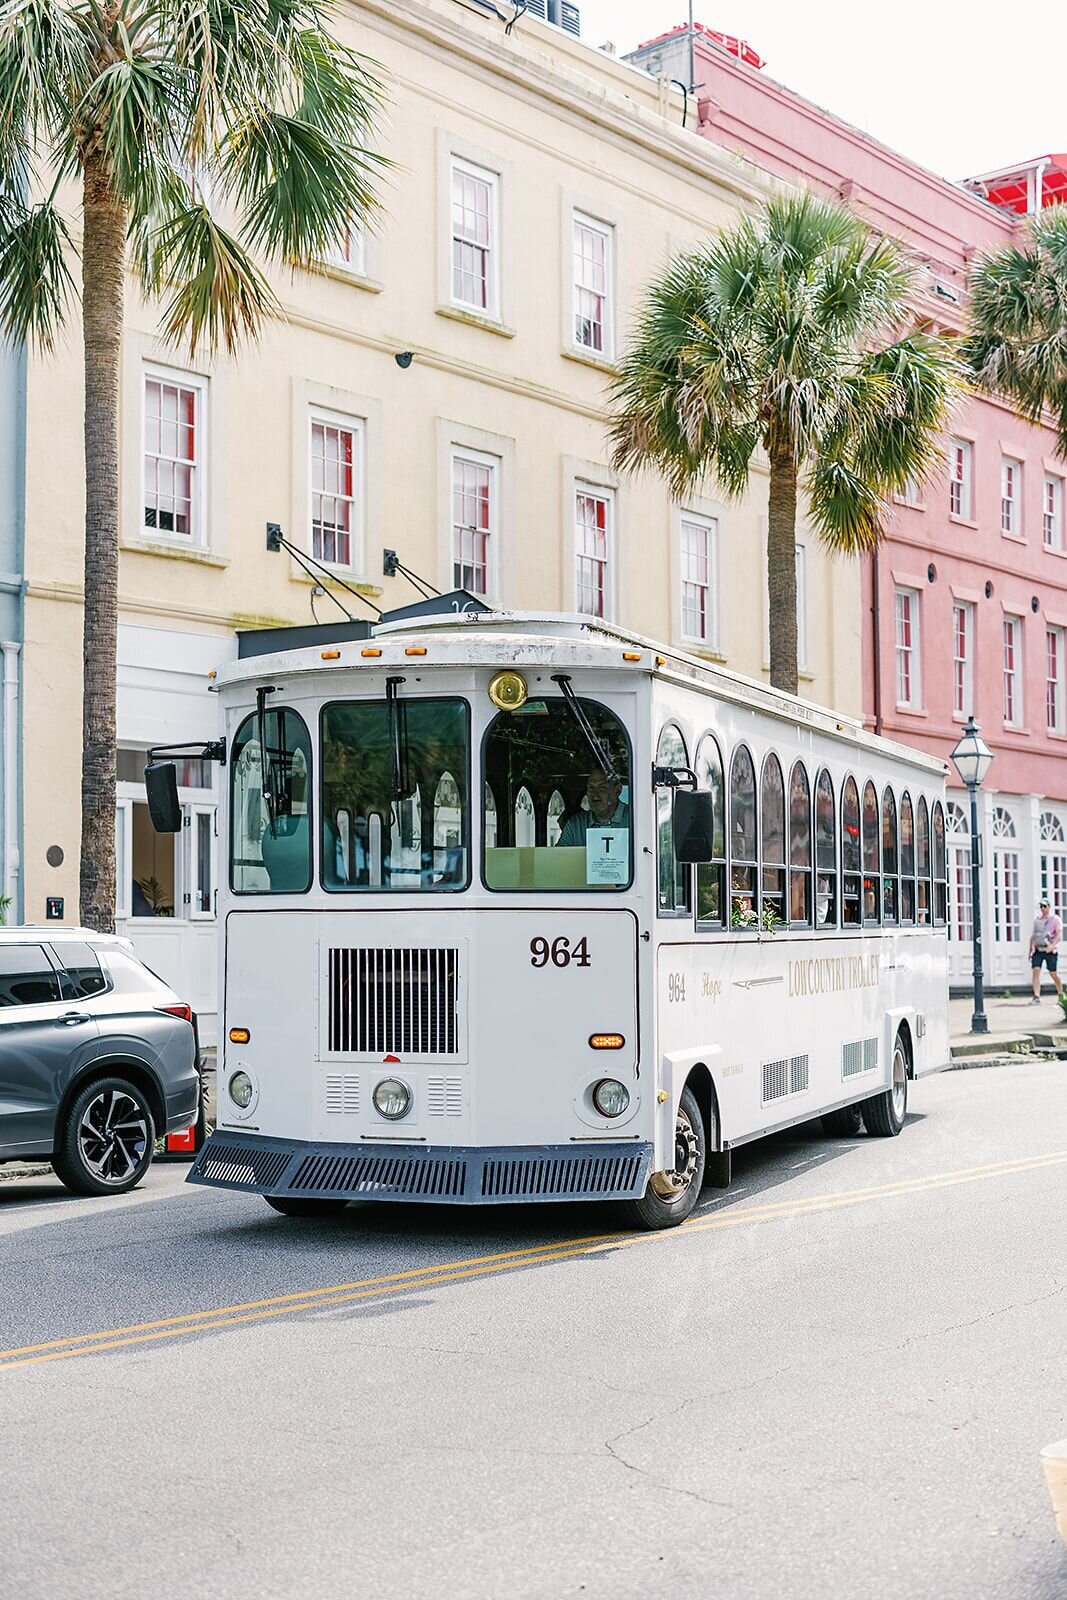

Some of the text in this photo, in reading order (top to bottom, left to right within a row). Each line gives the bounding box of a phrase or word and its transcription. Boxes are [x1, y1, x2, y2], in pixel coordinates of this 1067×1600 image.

[601, 836, 614, 853] T
[530, 936, 591, 968] 964
[668, 972, 686, 1003] 964
[702, 972, 721, 1003] Hope
[788, 955, 880, 997] LOWCOUNTRY TROLLEY
